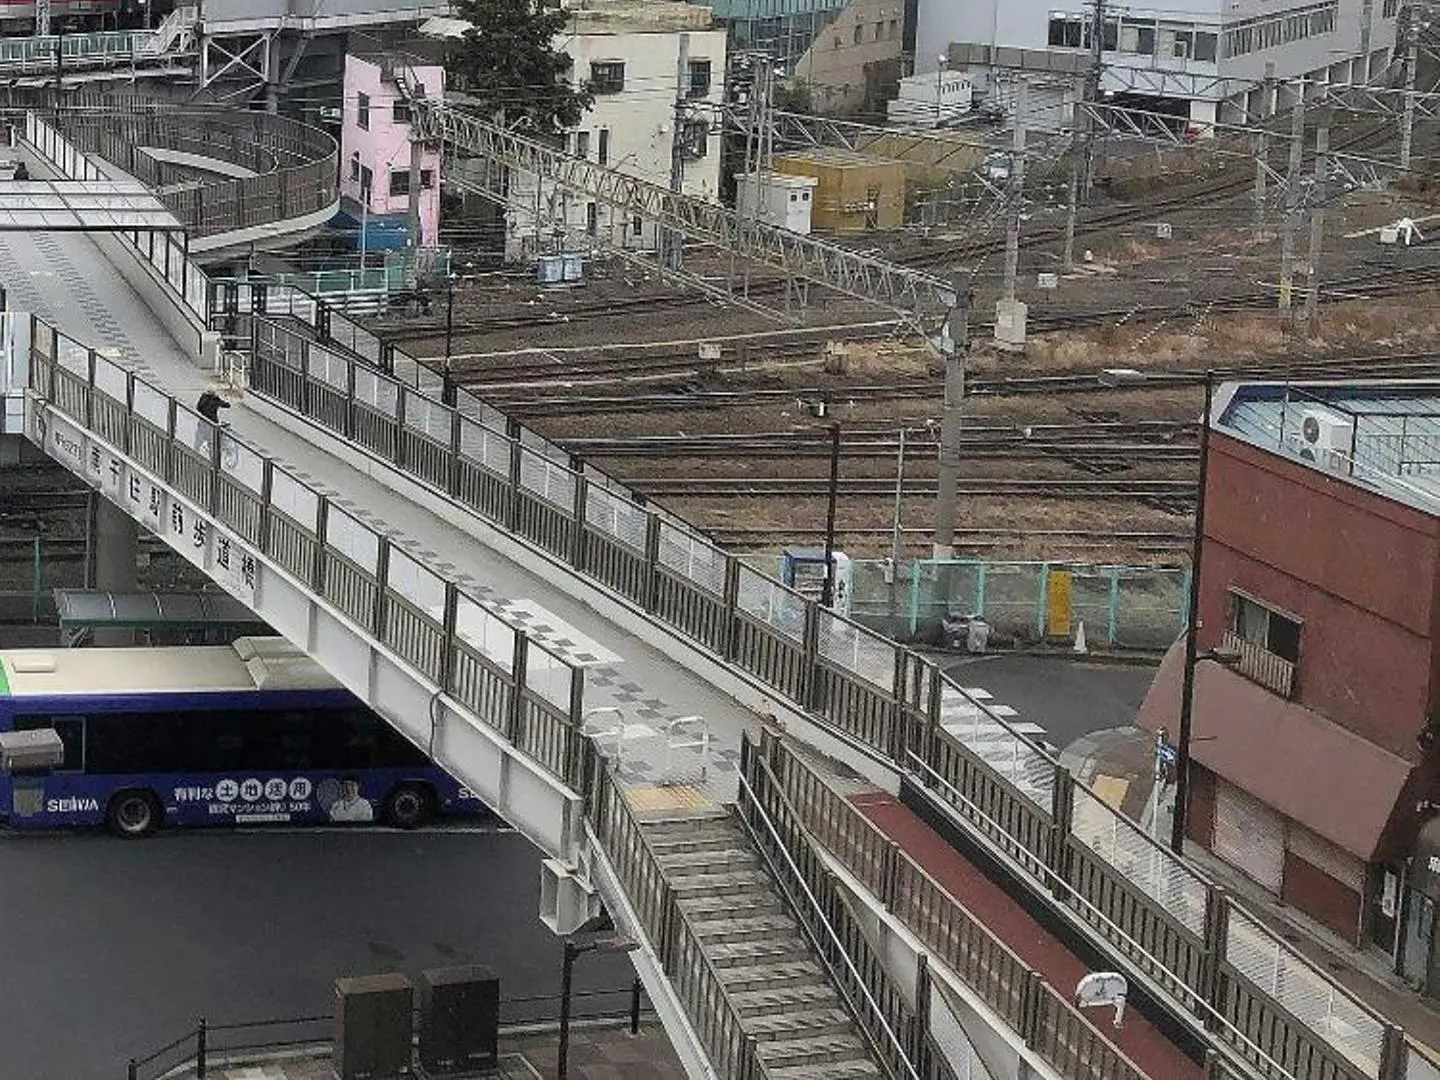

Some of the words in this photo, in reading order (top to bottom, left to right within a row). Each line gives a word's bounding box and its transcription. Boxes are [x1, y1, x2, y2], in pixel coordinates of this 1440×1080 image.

[90, 445, 255, 590] 南千住駅前歩道橋
